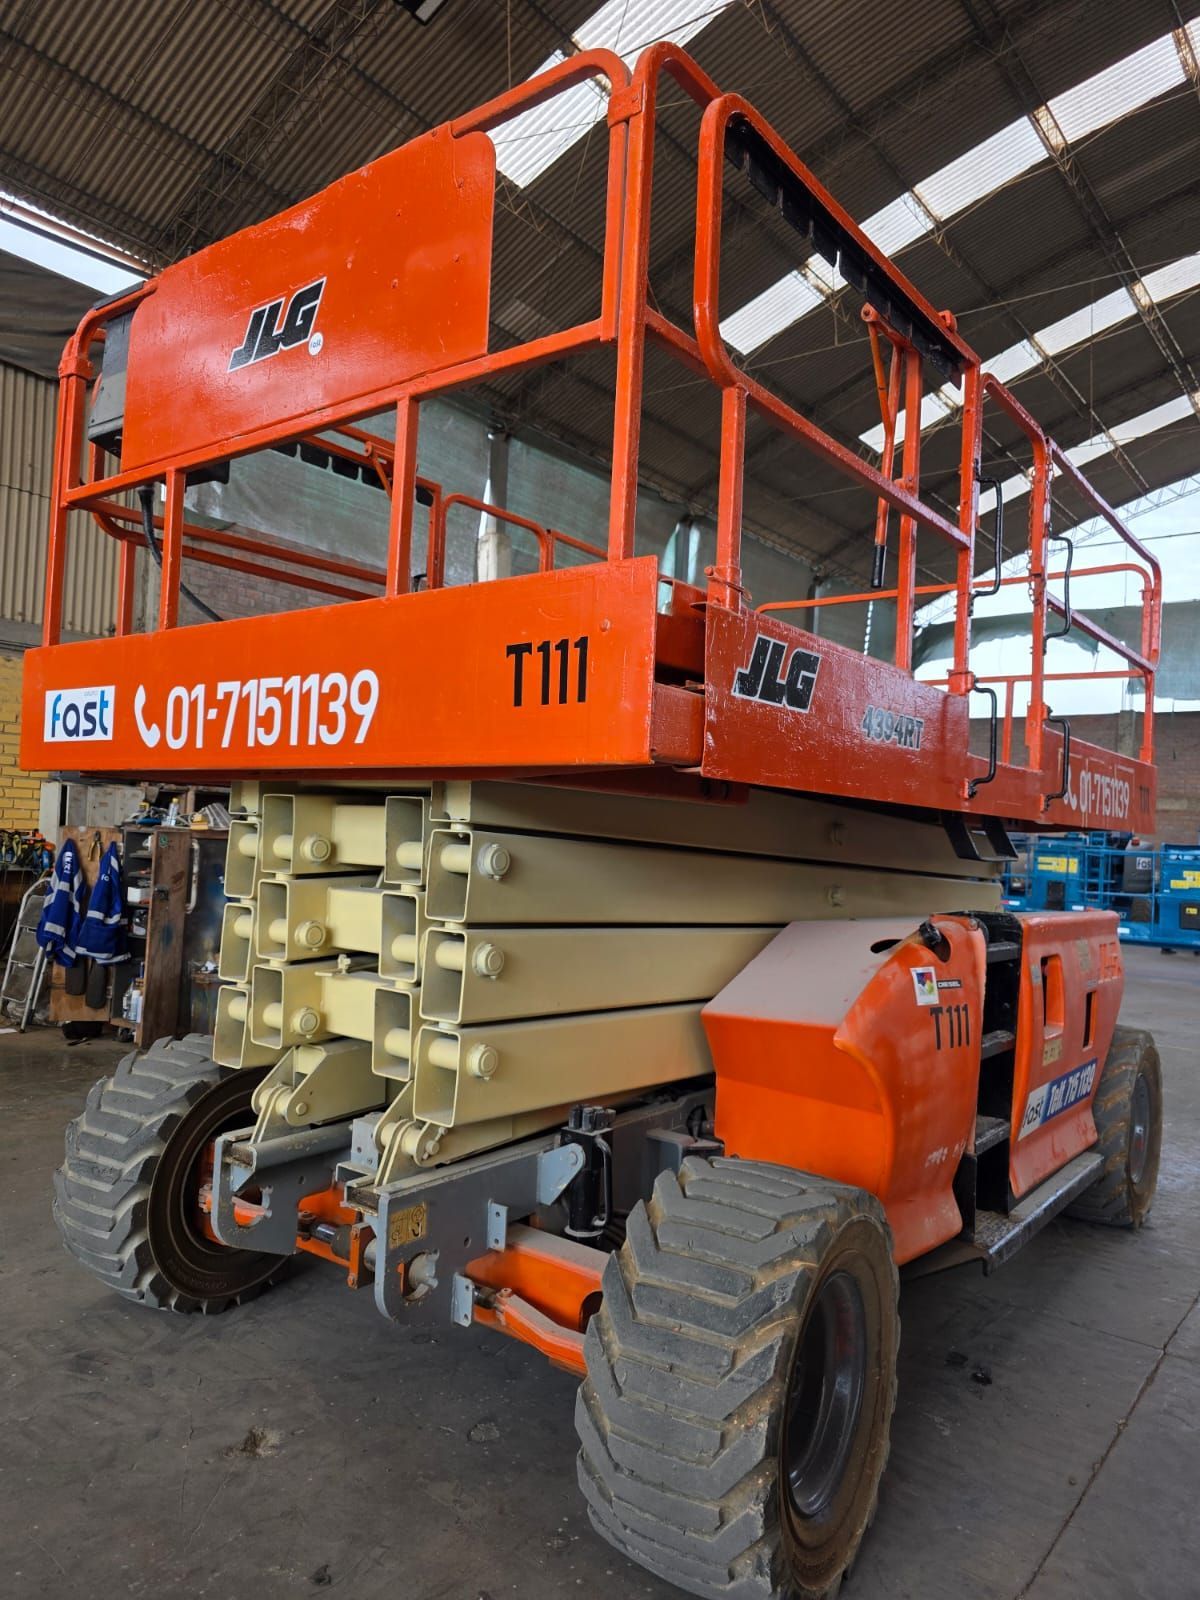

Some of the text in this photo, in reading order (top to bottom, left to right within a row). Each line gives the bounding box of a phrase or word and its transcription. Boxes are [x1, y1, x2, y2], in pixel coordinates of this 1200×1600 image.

[227, 276, 326, 372] JLG
[506, 636, 588, 707] T111
[731, 633, 821, 713] JLG
[51, 690, 109, 738] fast
[166, 669, 379, 750] 01-7151139
[862, 704, 925, 751] 4394RT
[930, 1004, 970, 1050] T111
